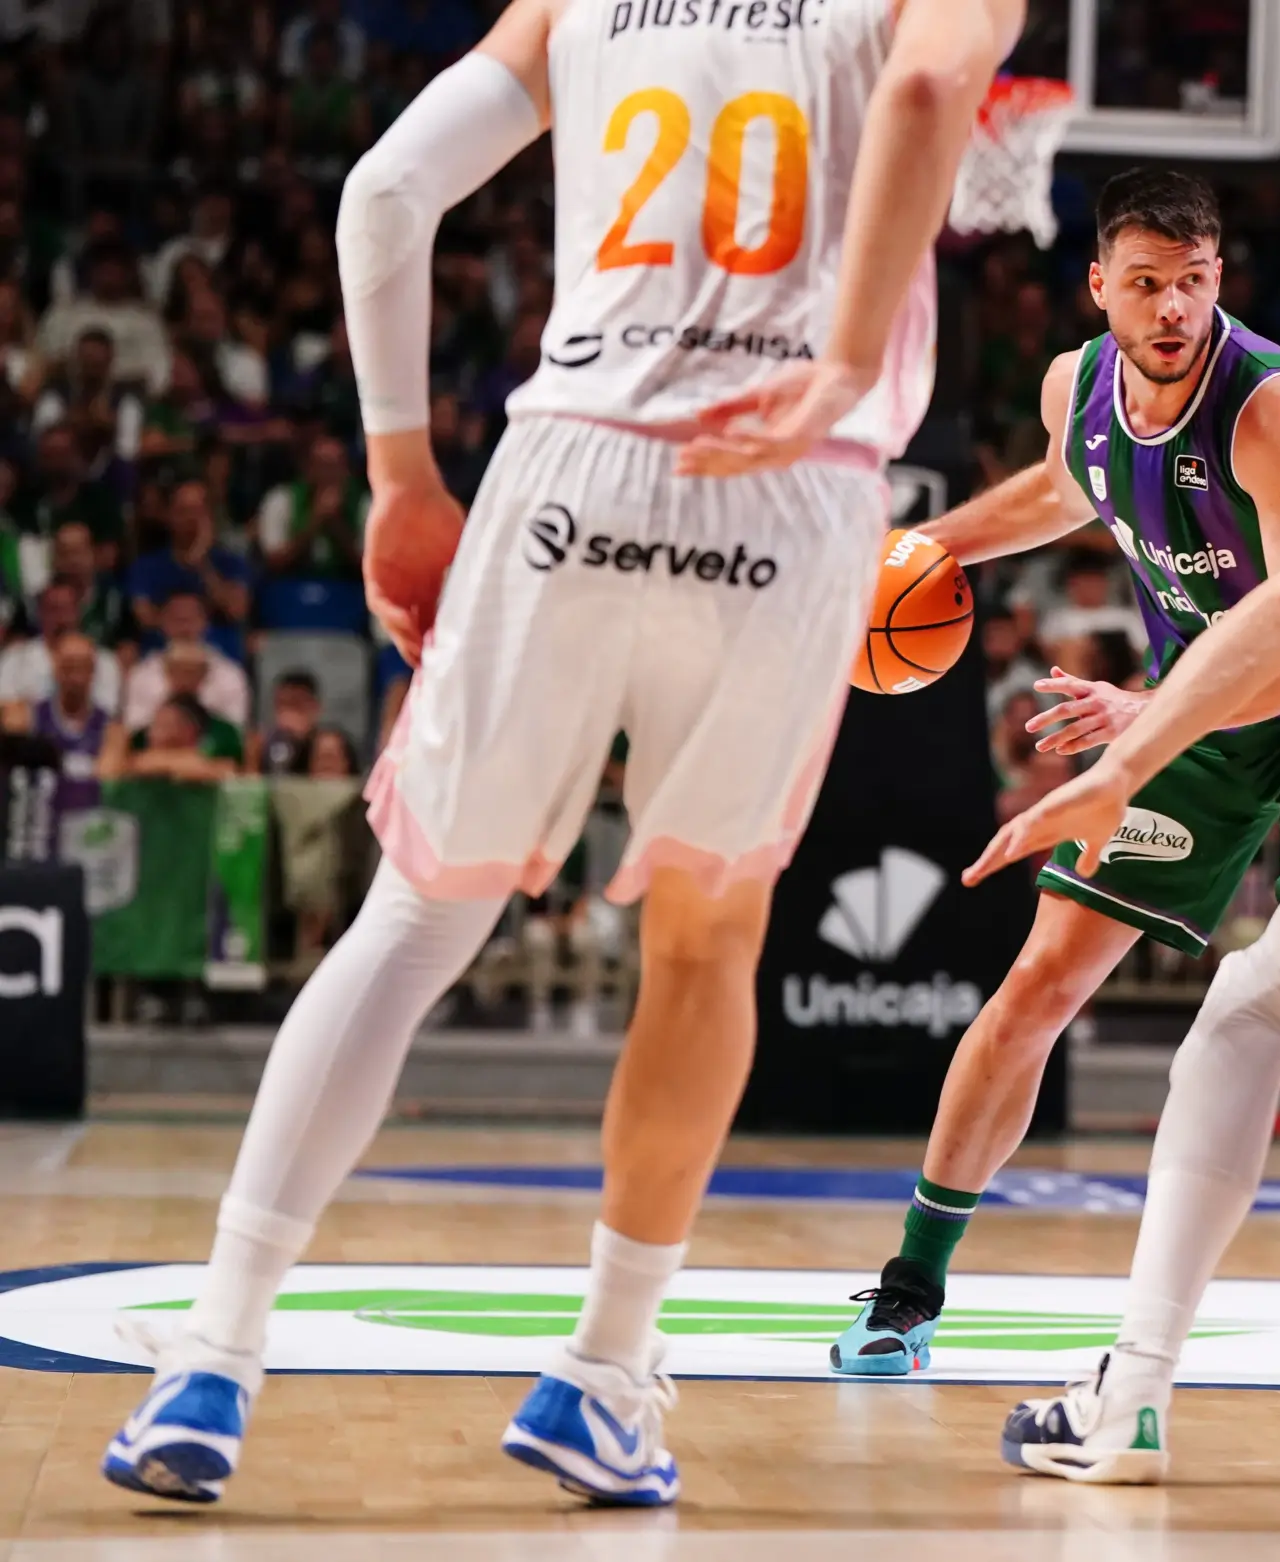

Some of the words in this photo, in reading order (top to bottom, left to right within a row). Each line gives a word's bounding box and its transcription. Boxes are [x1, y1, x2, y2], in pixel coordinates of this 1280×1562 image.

[595, 86, 809, 277] 20
[1179, 465, 1196, 476] liga
[581, 535, 778, 589] serveto
[1139, 540, 1237, 579] Unicaja
[782, 971, 982, 1038] Unicaja
